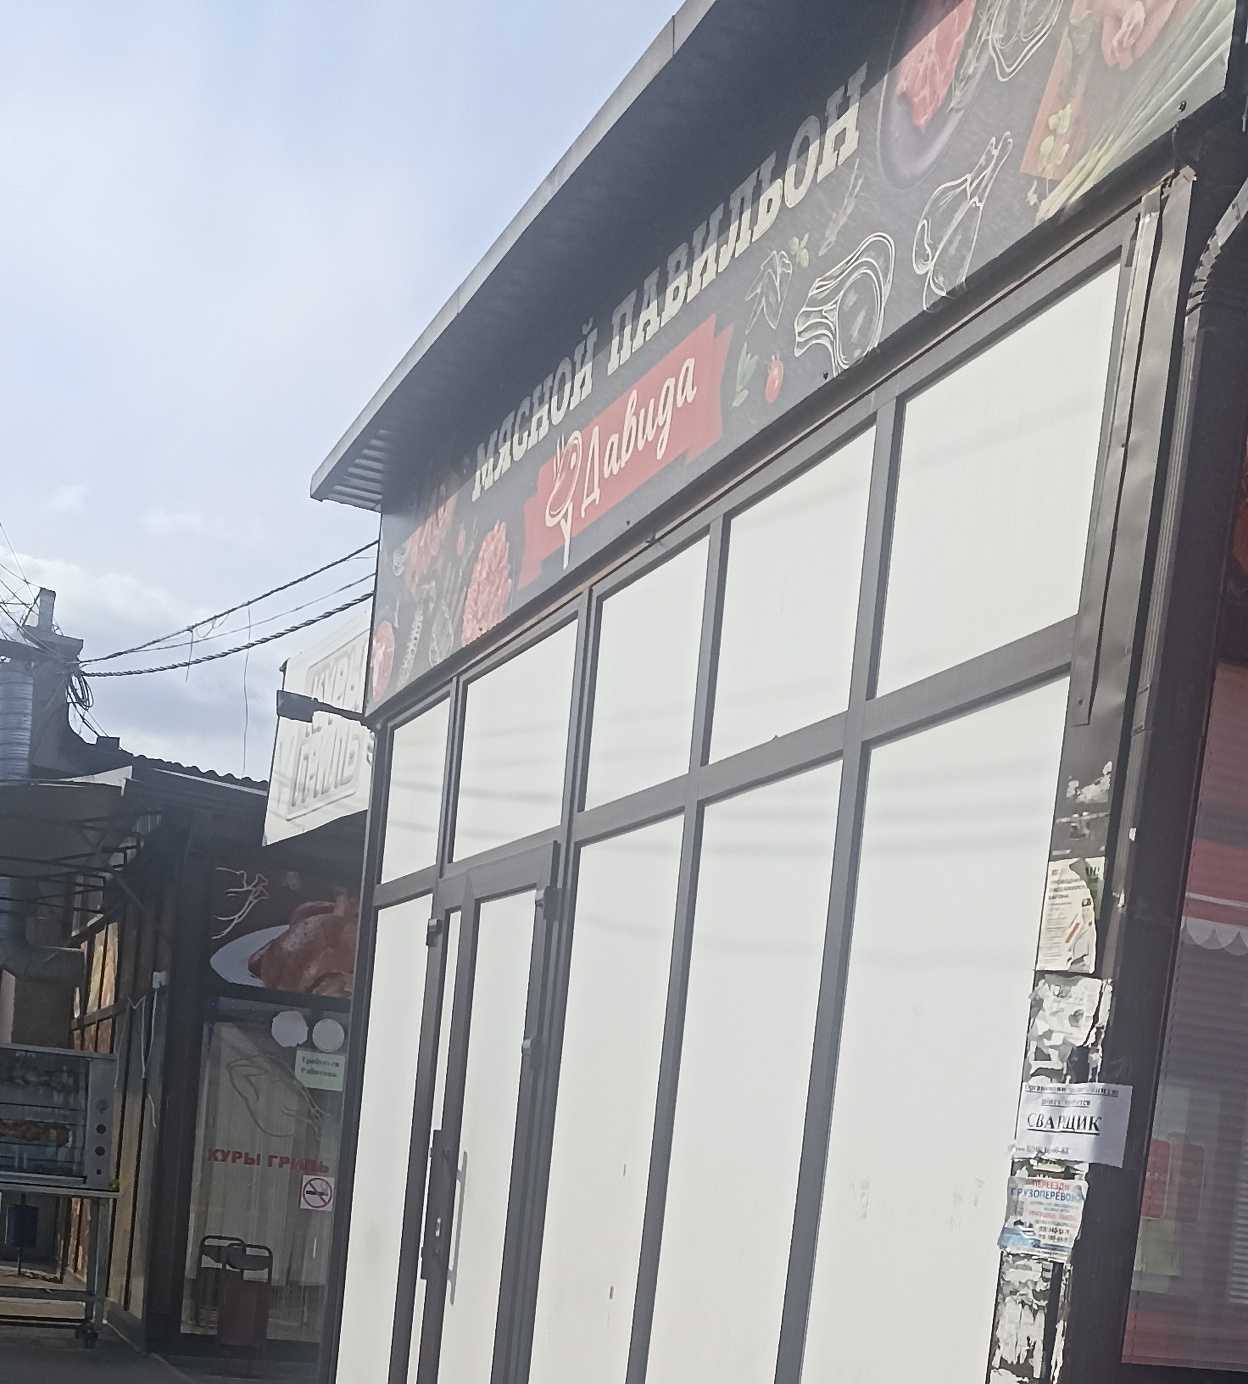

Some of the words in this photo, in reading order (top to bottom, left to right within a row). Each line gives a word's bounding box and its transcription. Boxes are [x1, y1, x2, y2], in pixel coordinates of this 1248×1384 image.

[471, 316, 599, 502] МЯСНОЙ
[606, 61, 868, 376] ПАВИЛЬОН
[580, 356, 697, 518] Давида
[208, 1148, 260, 1167] КУРЫ
[267, 1154, 329, 1174] ГРИЛЬ
